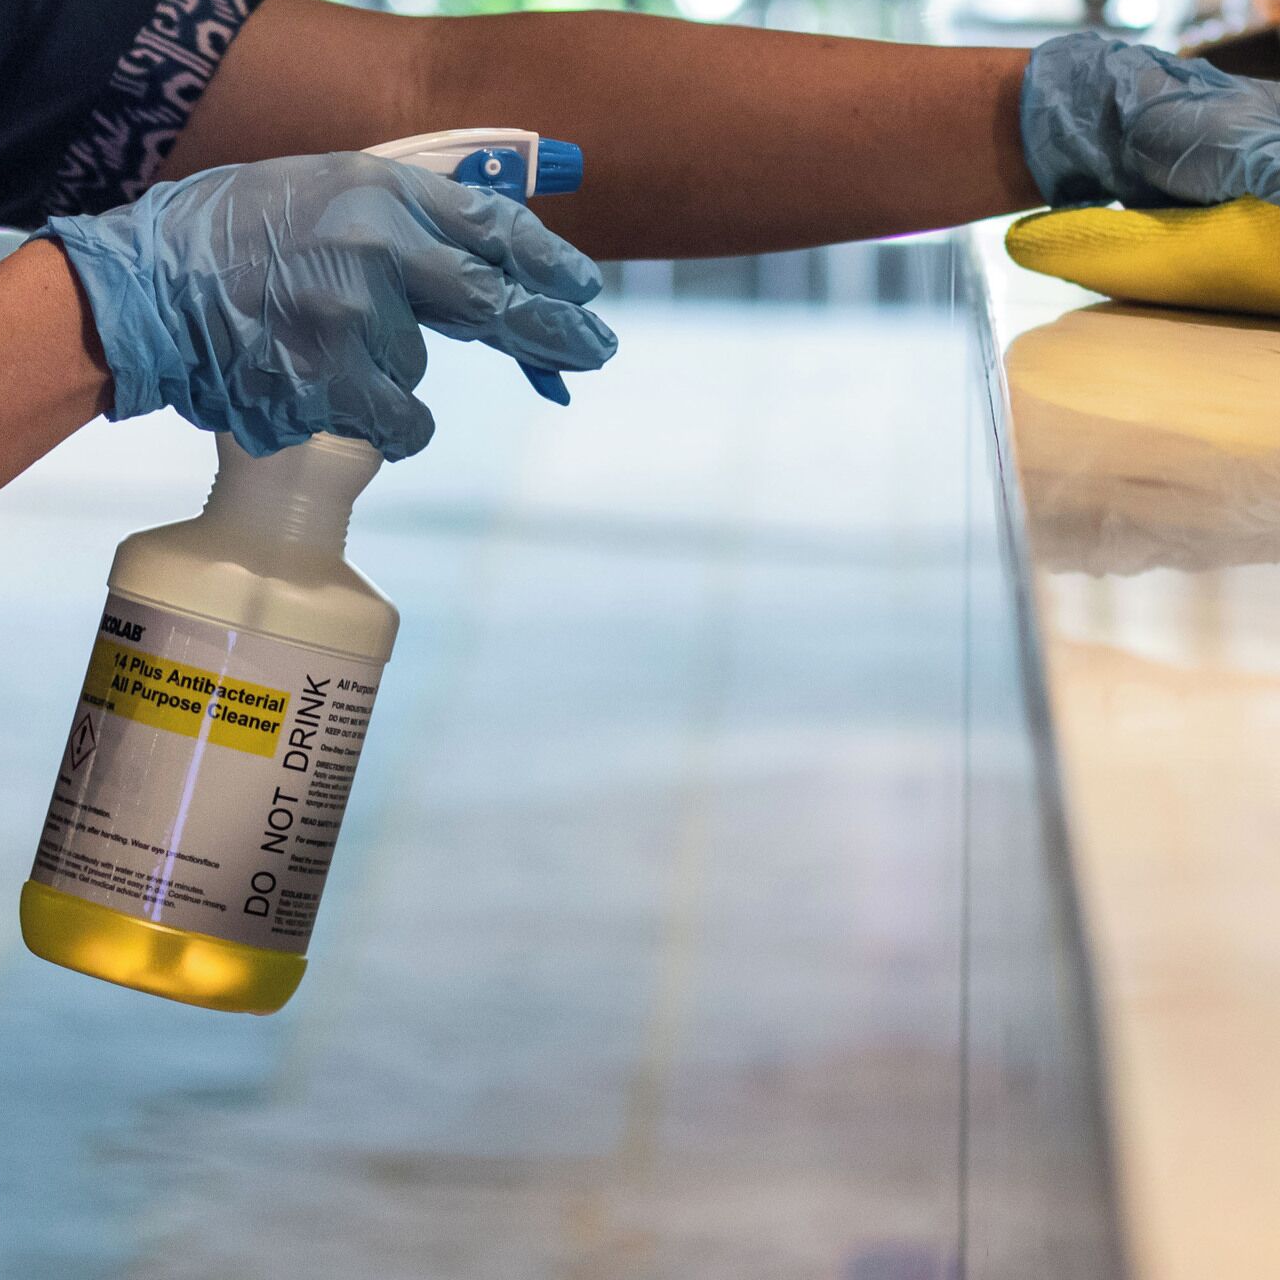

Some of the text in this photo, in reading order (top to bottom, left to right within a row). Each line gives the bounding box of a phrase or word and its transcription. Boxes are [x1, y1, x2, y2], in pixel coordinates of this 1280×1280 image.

[114, 653, 286, 713] 14 Plus Antibacterial
[337, 678, 350, 691] All
[111, 674, 129, 693] All
[131, 680, 202, 714] Purpose
[208, 703, 280, 734] Cleaner
[332, 701, 345, 710] FOR
[328, 714, 338, 722] DO
[339, 716, 350, 725] NOT
[325, 727, 341, 736] KEEP
[341, 730, 352, 738] OUT
[243, 674, 331, 918] DO NOT DRINK
[131, 839, 150, 850] Wear
[151, 846, 165, 856] eye
[168, 890, 201, 904] Continue
